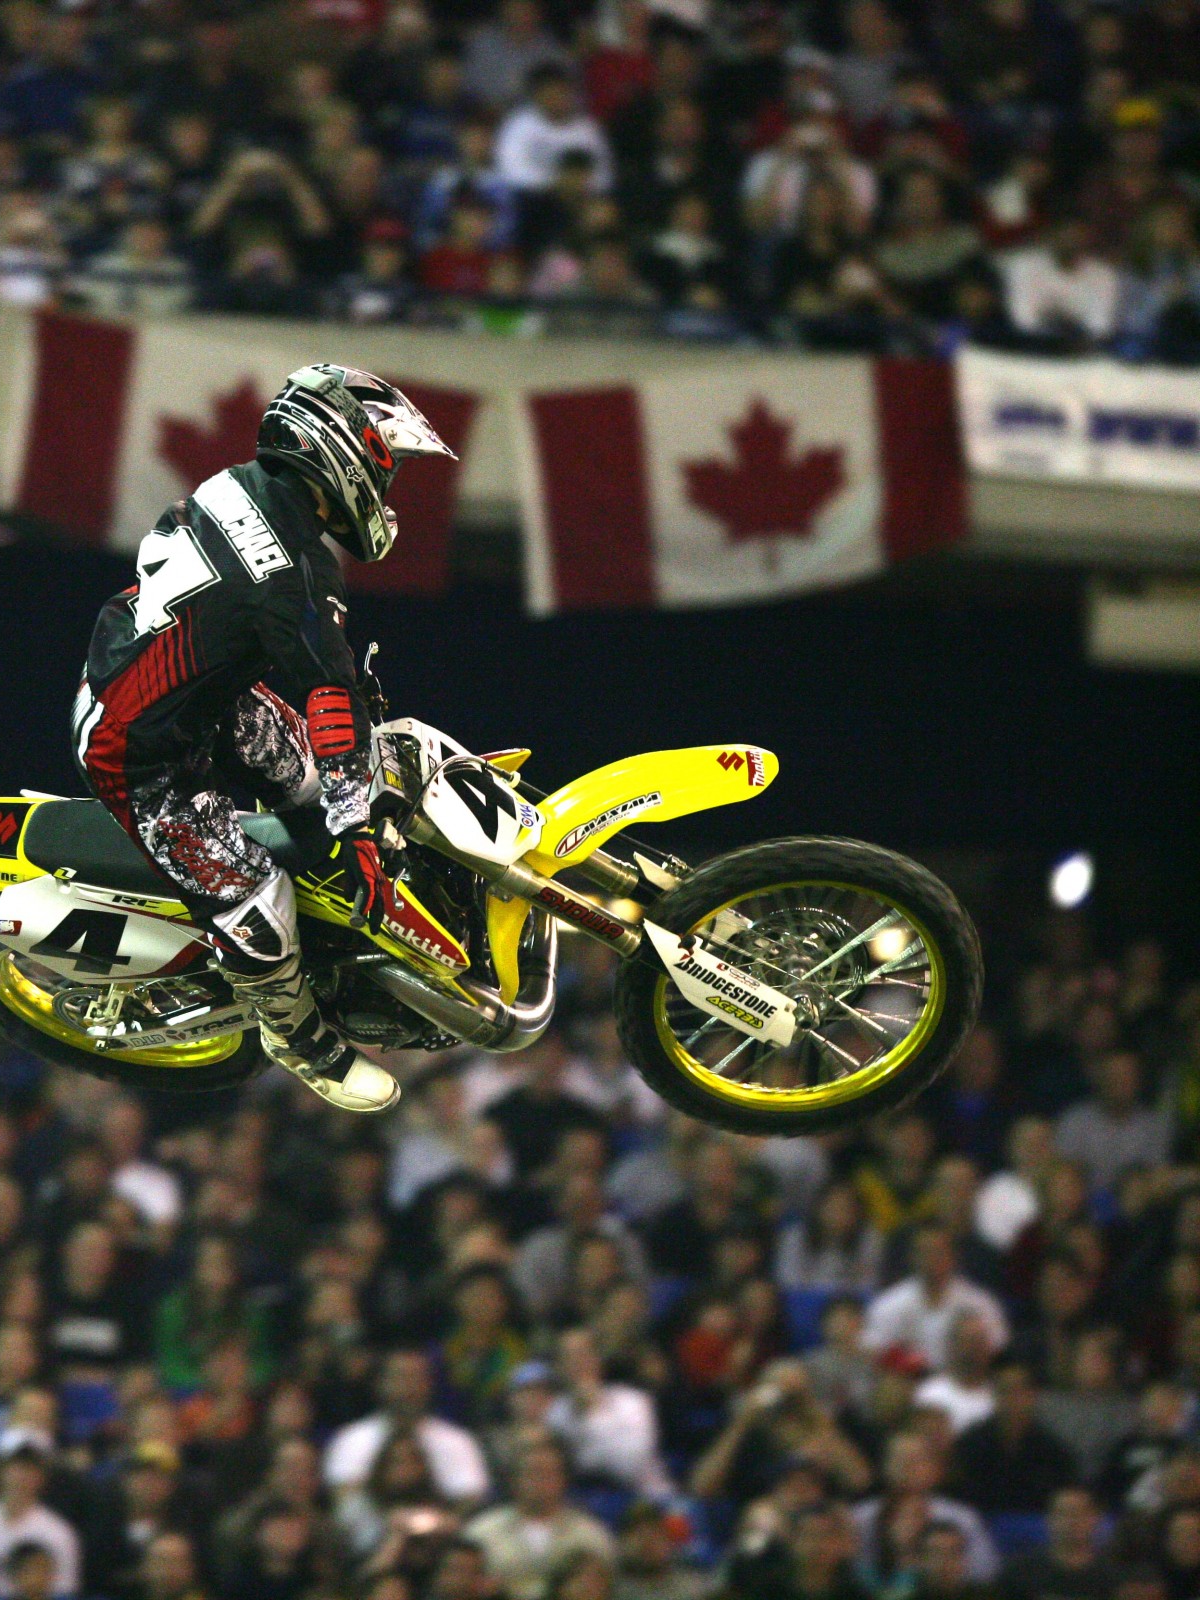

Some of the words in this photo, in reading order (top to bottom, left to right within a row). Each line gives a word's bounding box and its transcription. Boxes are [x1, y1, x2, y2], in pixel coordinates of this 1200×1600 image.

[127, 525, 222, 640] 4
[441, 742, 517, 845] 4
[28, 908, 131, 975] 4
[540, 887, 625, 940] SHOWA
[673, 953, 778, 1019] BRIDGESTONE
